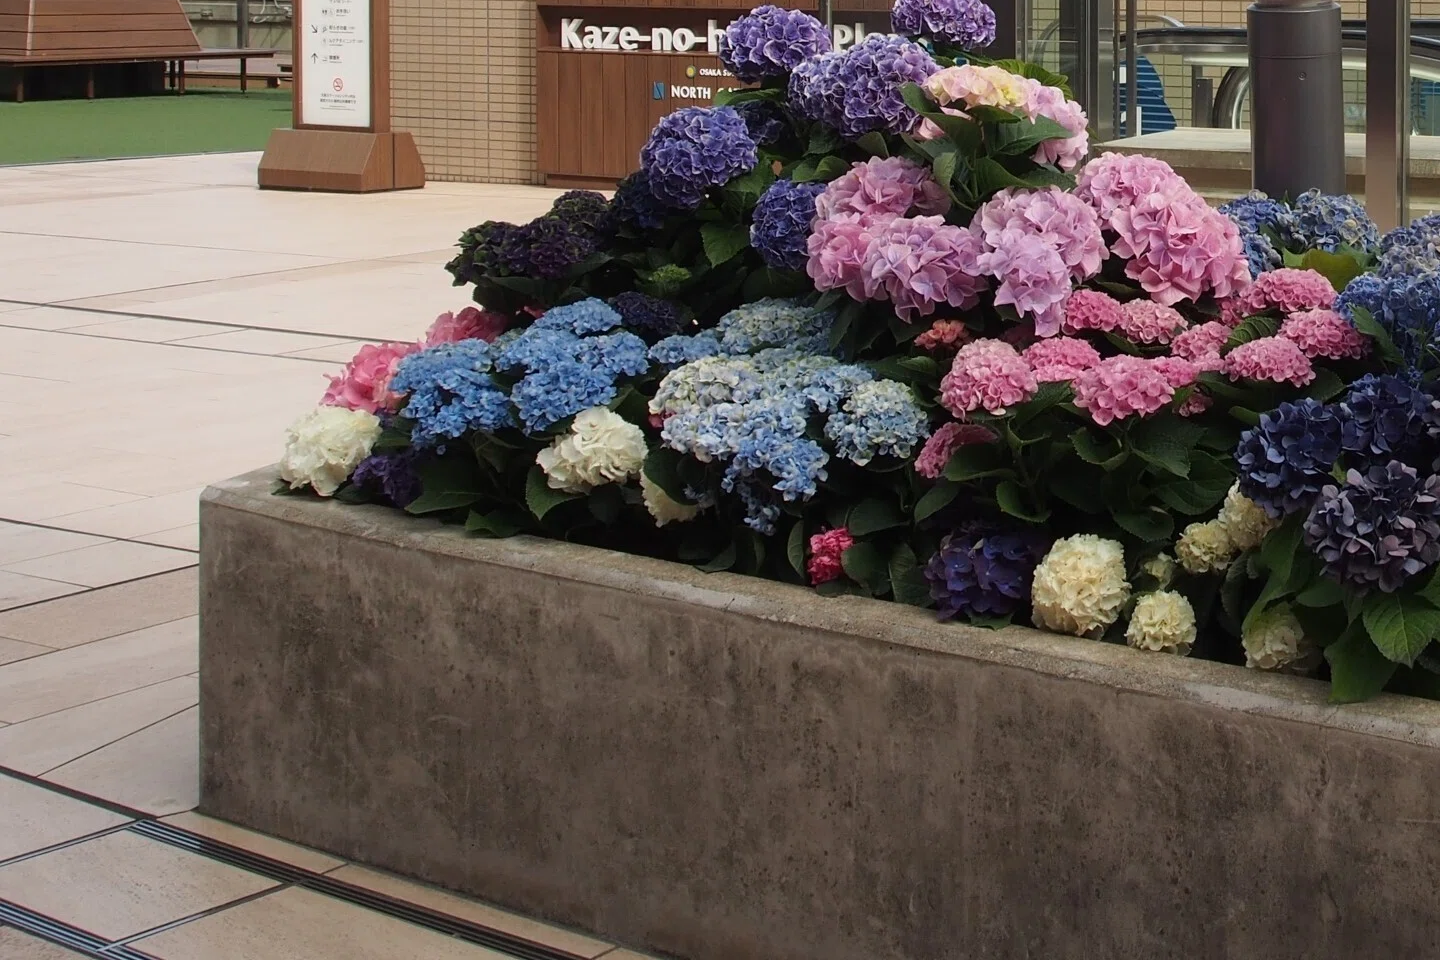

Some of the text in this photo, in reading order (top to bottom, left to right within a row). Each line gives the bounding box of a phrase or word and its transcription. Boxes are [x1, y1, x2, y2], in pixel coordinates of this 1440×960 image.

[561, 18, 738, 54] Kaze-no-h
[700, 68, 721, 77] OSAKA
[671, 85, 711, 100] NORTH
